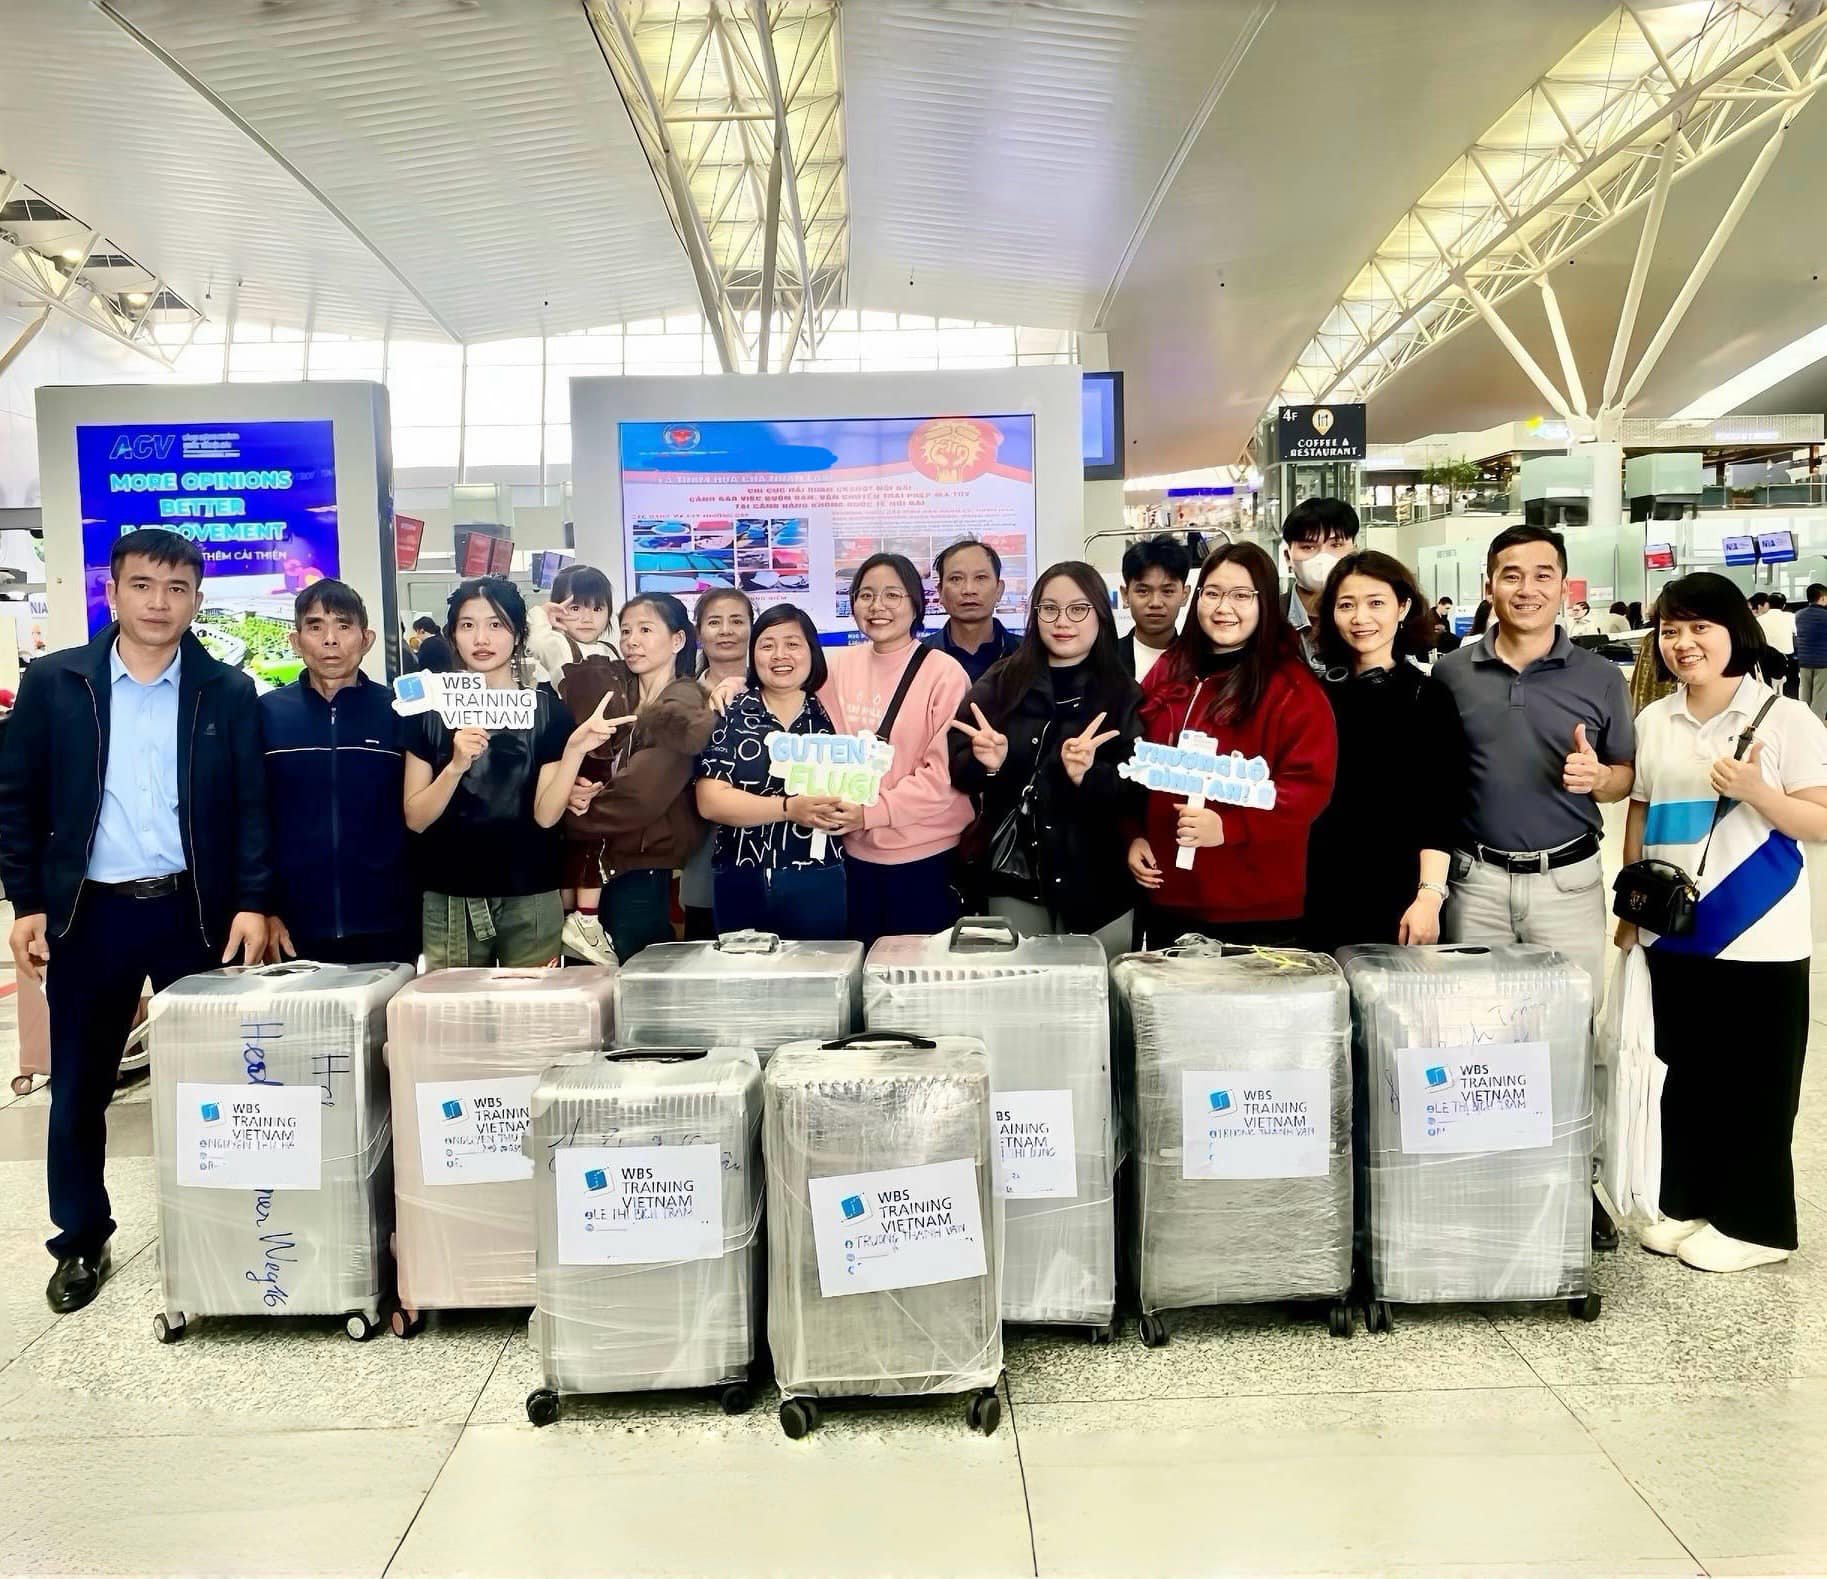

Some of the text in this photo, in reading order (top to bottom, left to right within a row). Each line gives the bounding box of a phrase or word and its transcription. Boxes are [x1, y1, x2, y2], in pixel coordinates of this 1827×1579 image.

[1282, 409, 1299, 422] 4F
[1297, 437, 1350, 448] COFFEE &
[1290, 446, 1358, 457] RESTAURANT
[110, 472, 178, 492] MORE
[181, 470, 293, 491] OPINIONS
[159, 497, 246, 518] BETTER
[202, 549, 231, 561] THÊM
[442, 676, 482, 690] WBS
[442, 692, 533, 708] TRAINING
[443, 710, 530, 726] VIETNAM
[772, 735, 866, 765] GUTEN
[1460, 1064, 1489, 1076] WBS
[1460, 1074, 1527, 1089] TRAINING
[1243, 1089, 1273, 1101] WBS
[1461, 1088, 1526, 1103] VIETNAM
[232, 1103, 260, 1114] WBS
[473, 1097, 503, 1108] WBS
[1243, 1102, 1308, 1115] TRAINING
[475, 1107, 530, 1121] TRAININ
[996, 1111, 1011, 1121] BS
[232, 1115, 296, 1128] TRAINING
[476, 1120, 530, 1134] VIETNA
[1244, 1115, 1307, 1129] VIETNAM
[232, 1129, 295, 1141] VIETNAM
[1000, 1123, 1049, 1135] AINING
[621, 1168, 653, 1179] WBS
[622, 1180, 694, 1194] TRAINING
[621, 1195, 693, 1209] VIETNAM
[878, 1189, 910, 1204] WBS
[879, 1197, 952, 1219] TRAINING
[881, 1213, 952, 1234] VIETNAM
